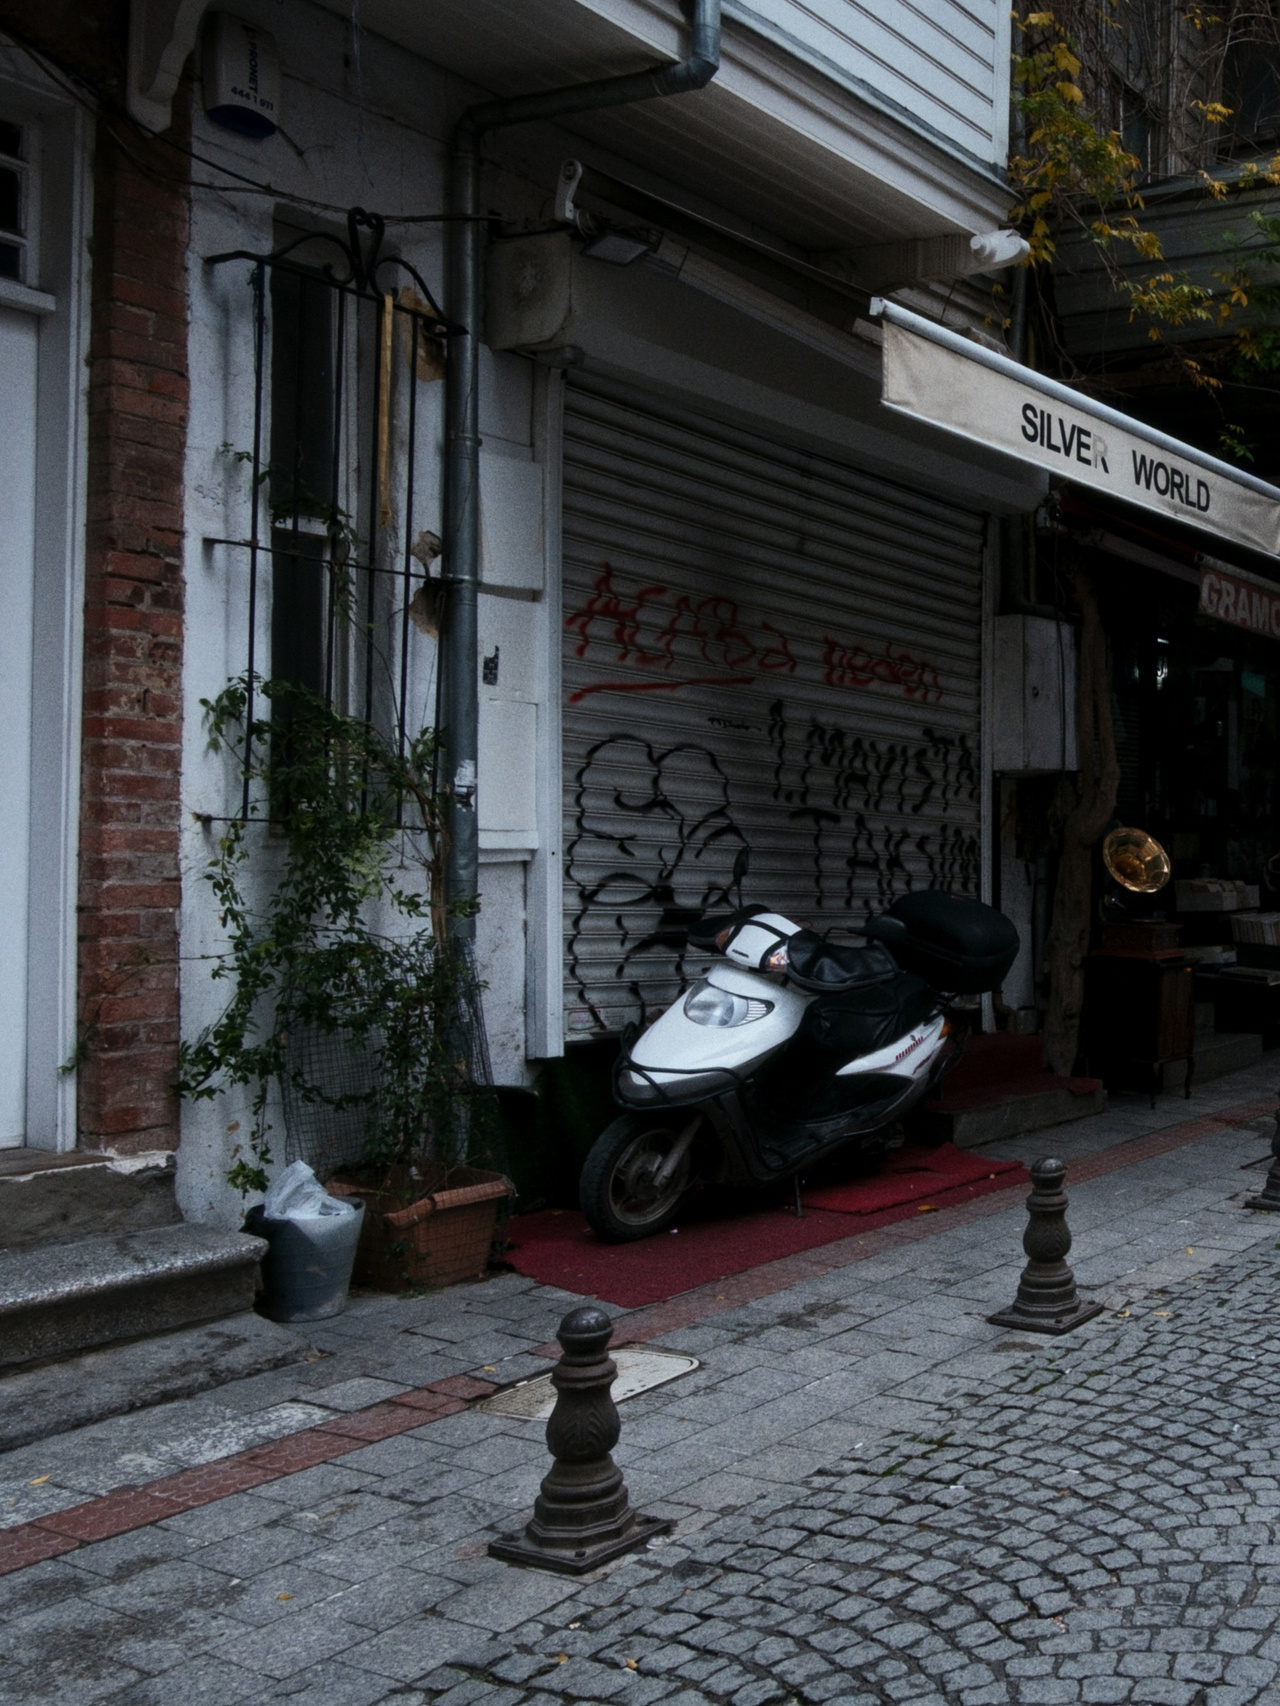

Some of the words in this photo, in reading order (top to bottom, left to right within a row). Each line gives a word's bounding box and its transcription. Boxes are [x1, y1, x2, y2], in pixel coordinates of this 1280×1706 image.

[248, 41, 258, 94] PRONET
[231, 86, 251, 101] 444
[260, 98, 274, 111] 911
[1132, 449, 1210, 513] WORLD
